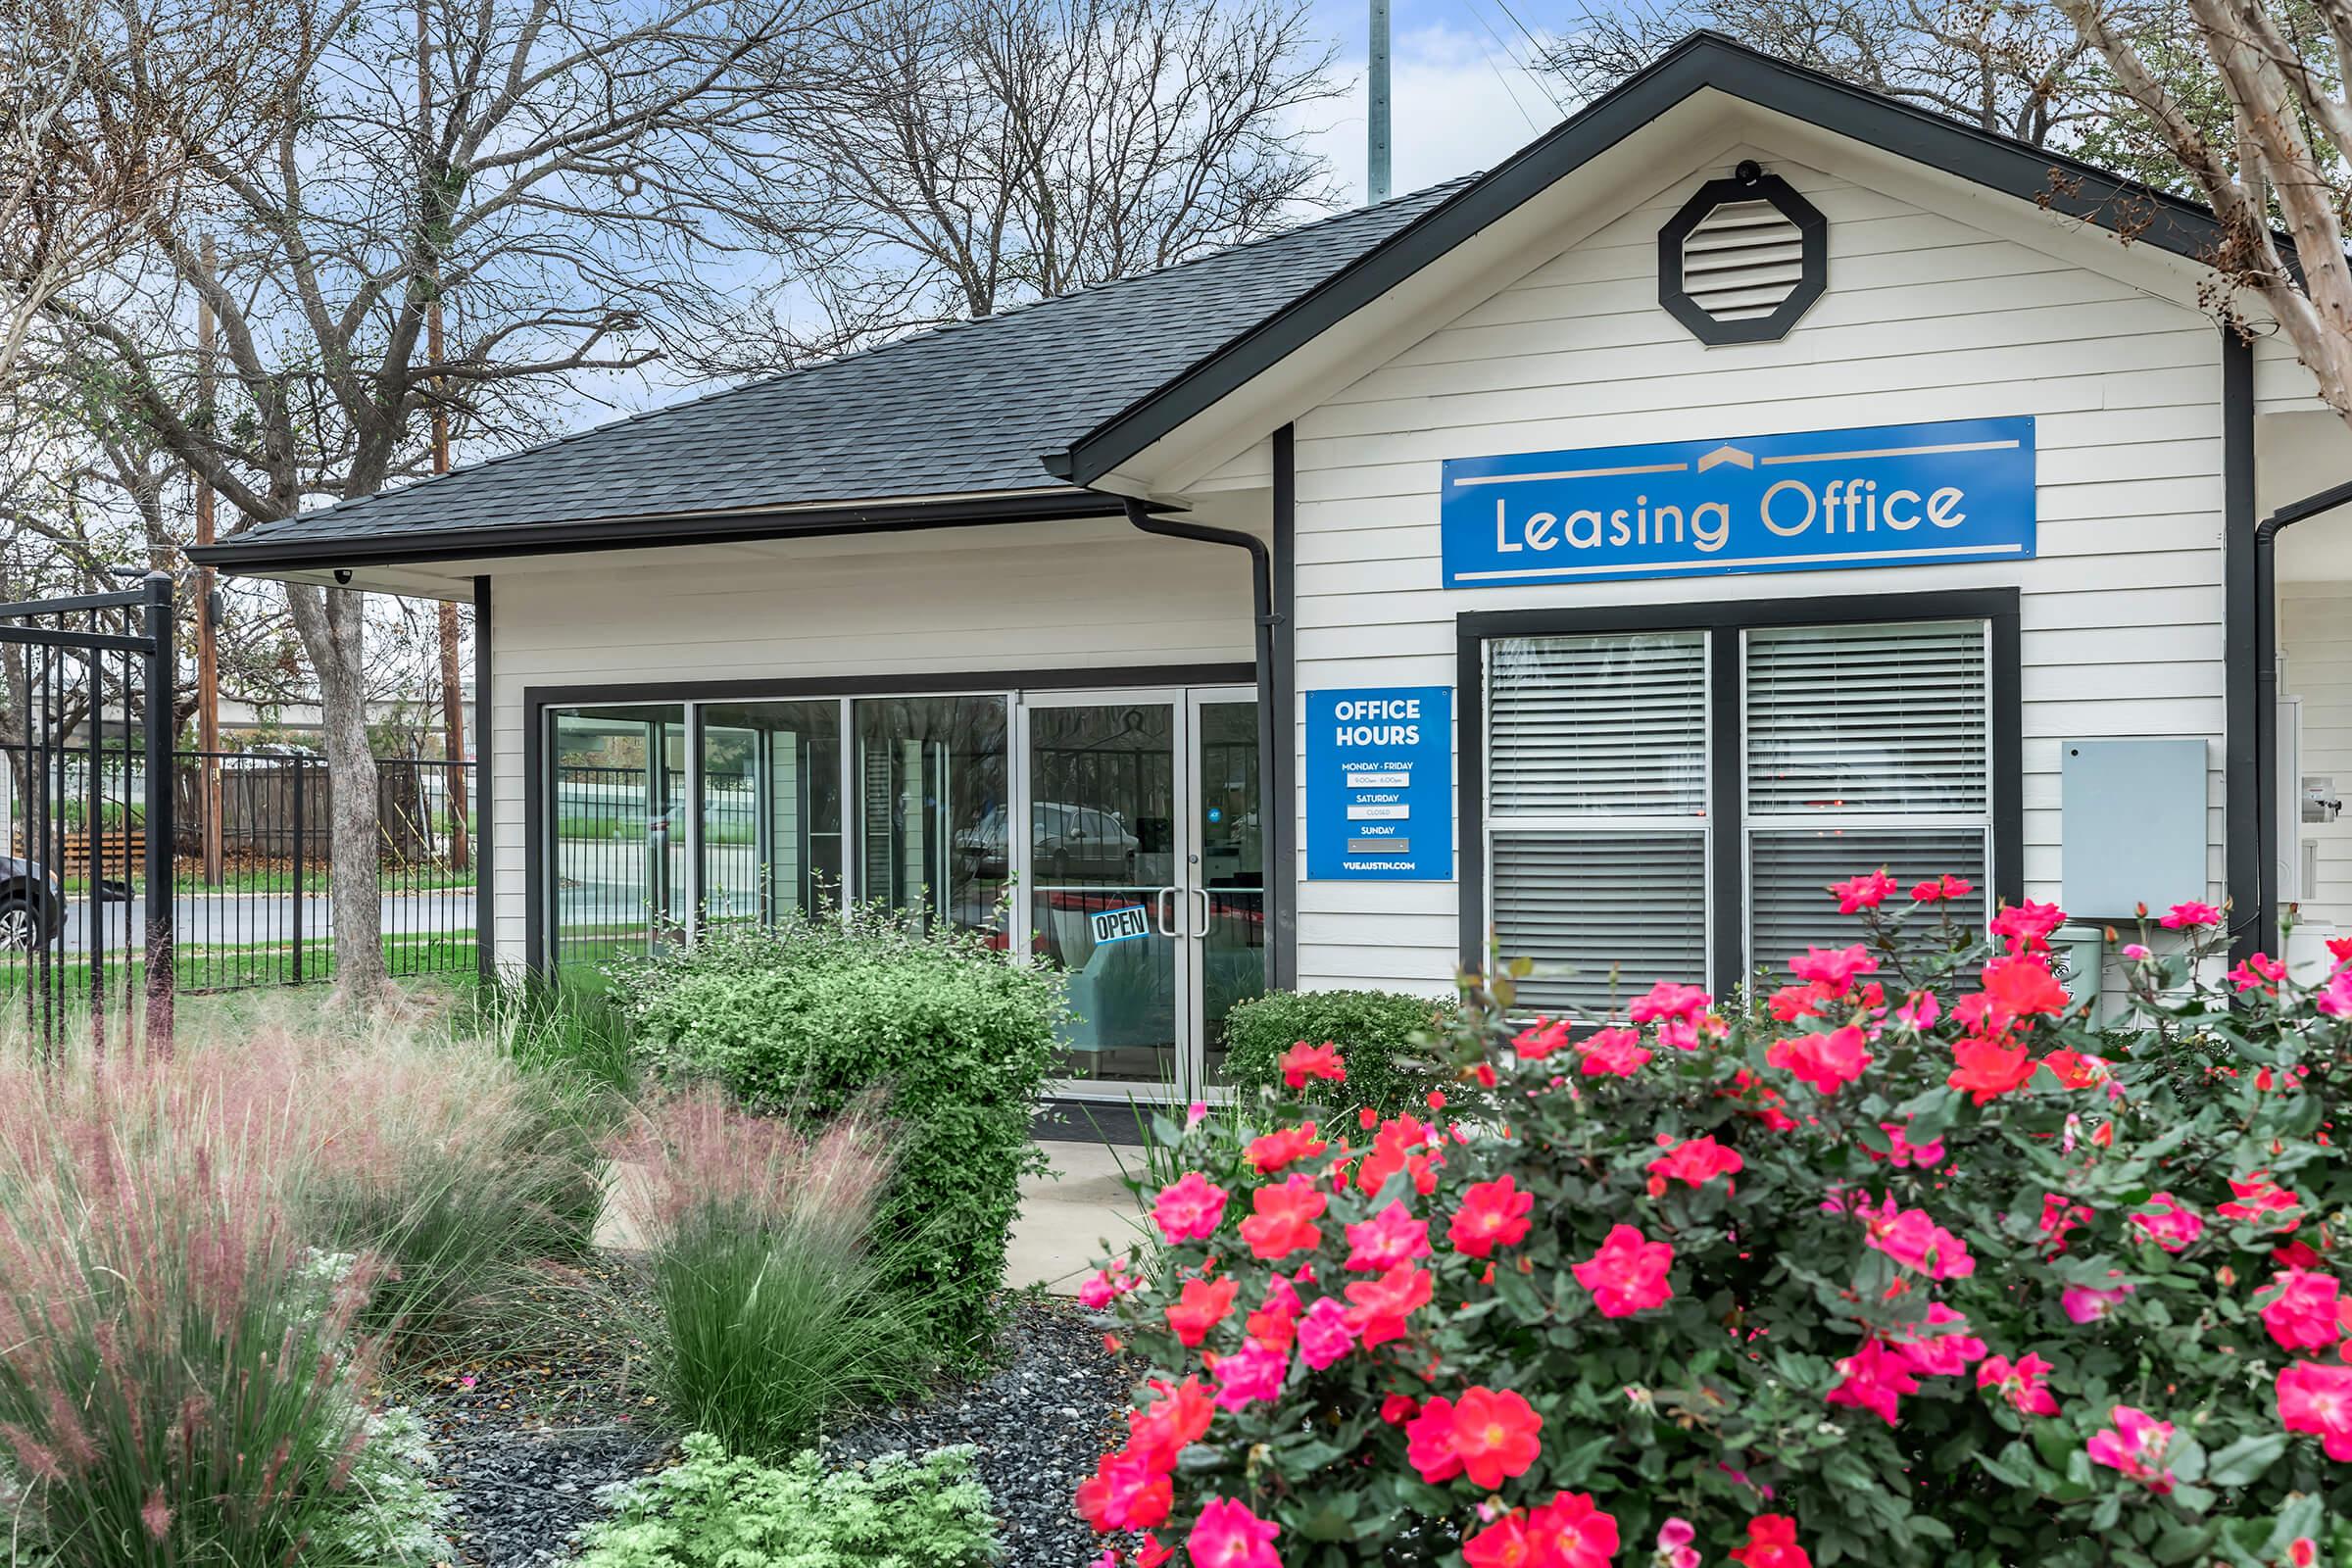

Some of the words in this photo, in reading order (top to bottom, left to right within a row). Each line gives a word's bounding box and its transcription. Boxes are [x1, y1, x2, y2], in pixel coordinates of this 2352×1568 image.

[1495, 495, 1731, 553] Leasing
[1760, 478, 1968, 538] Office
[1334, 699, 1421, 721] OFFICE
[1336, 725, 1420, 746] HOURS
[1342, 762, 1379, 771] MONDAY
[1384, 761, 1413, 770] FRIDAY
[1355, 794, 1399, 803] SATURDAY
[1360, 826, 1396, 835] SUNDAY
[1096, 908, 1146, 941] OPEN
